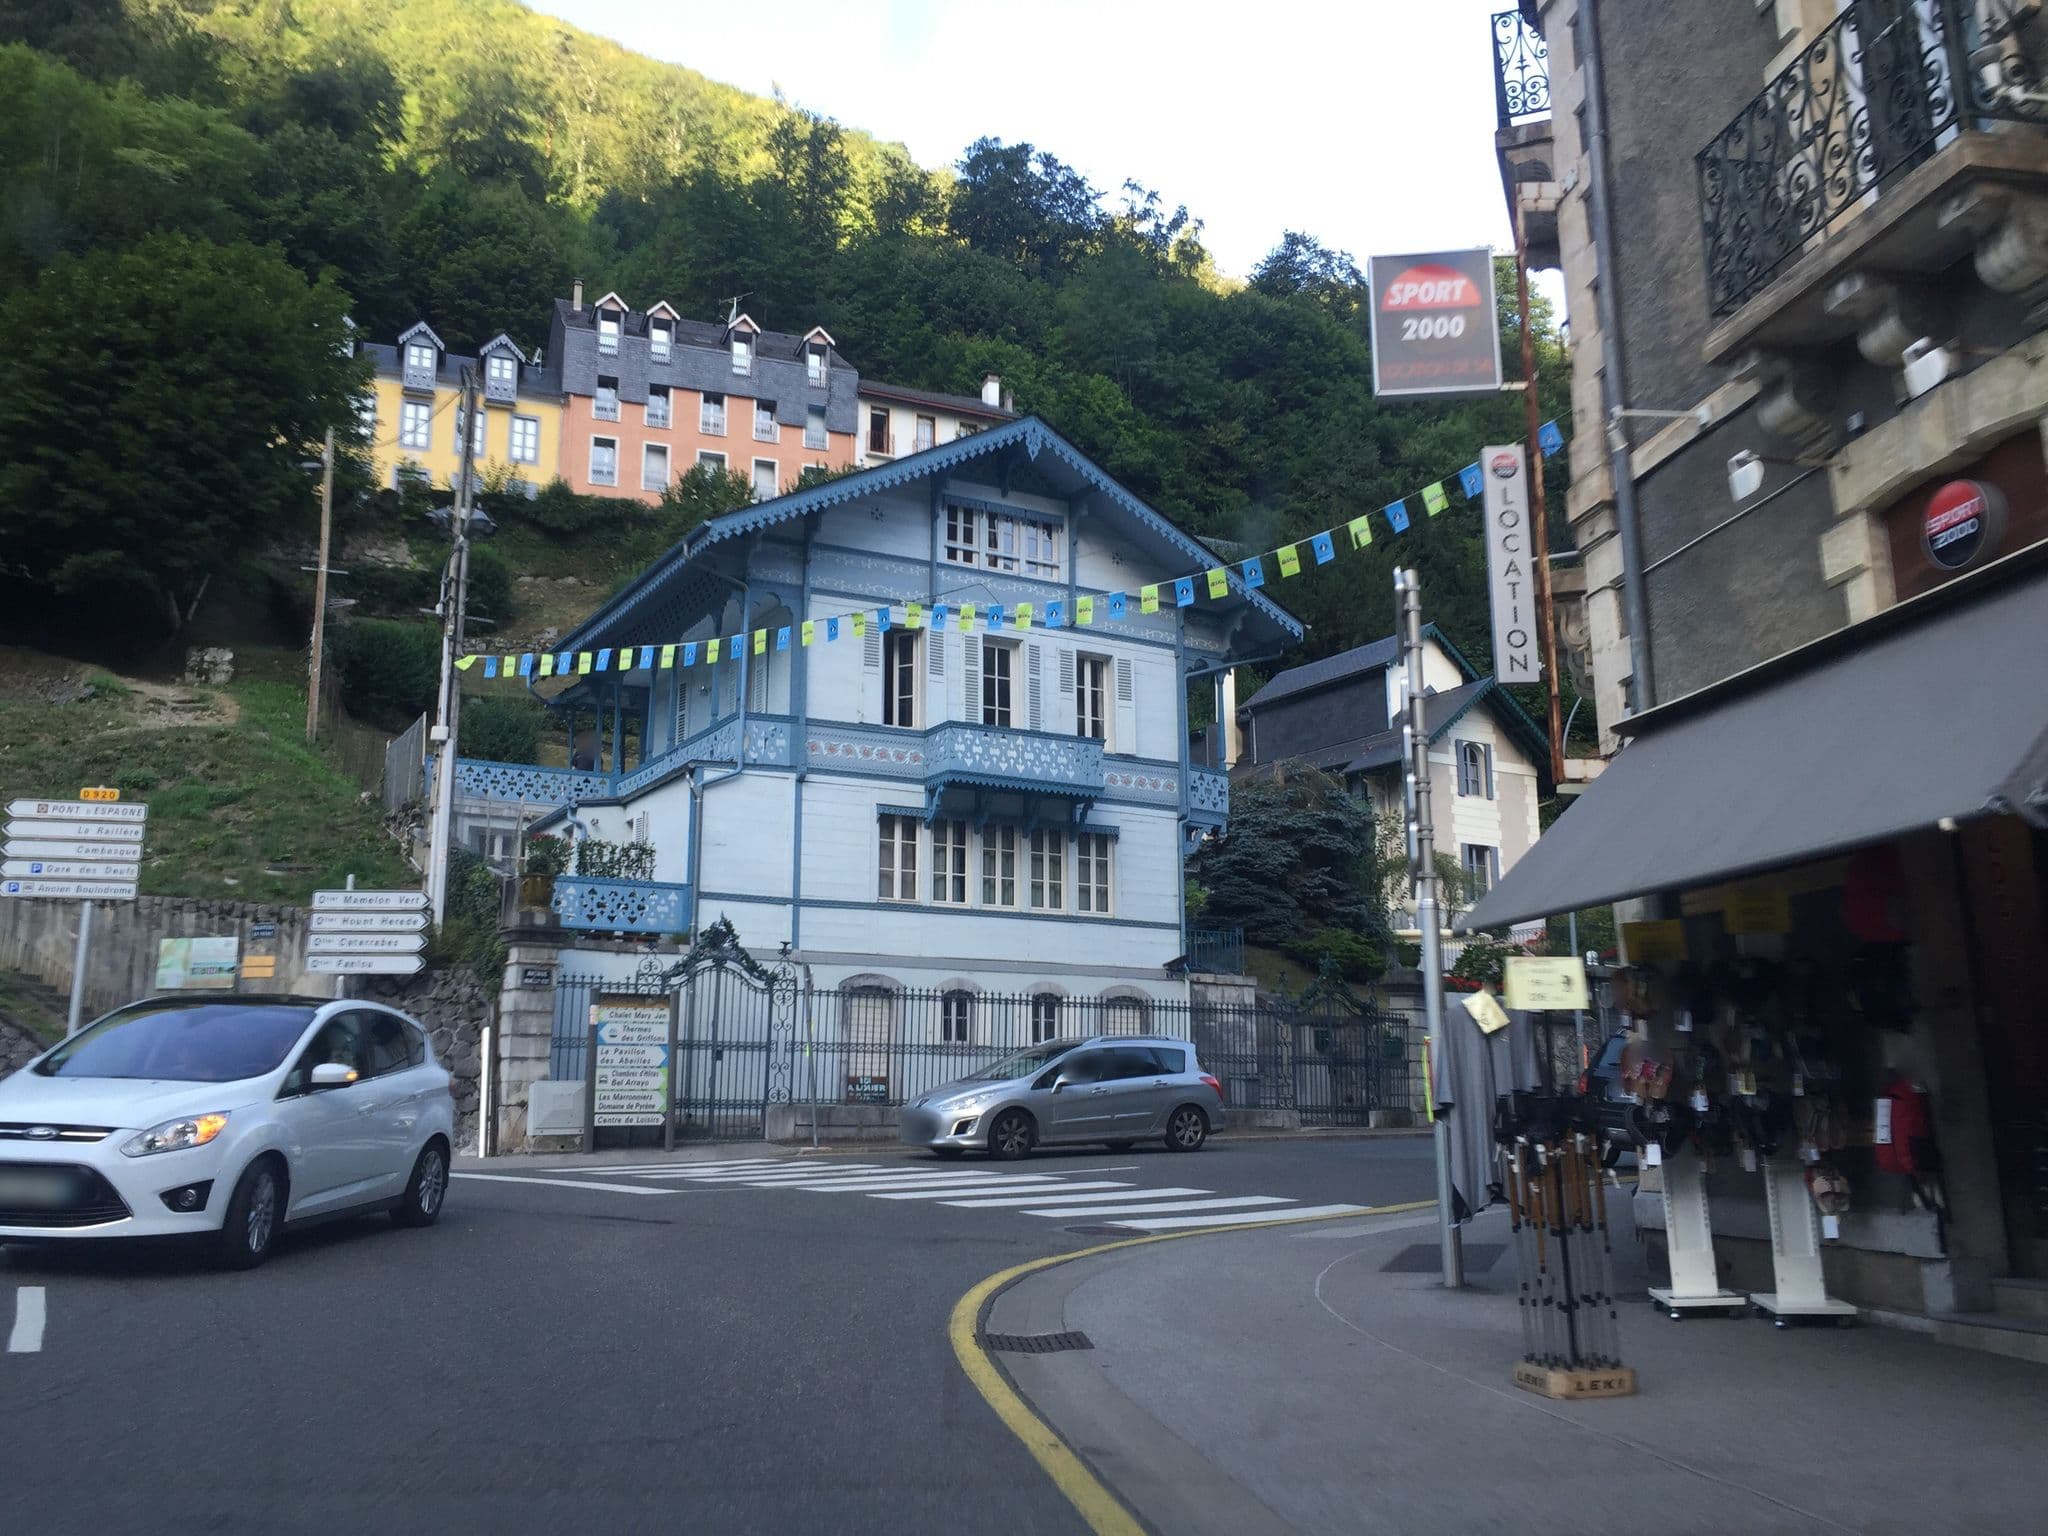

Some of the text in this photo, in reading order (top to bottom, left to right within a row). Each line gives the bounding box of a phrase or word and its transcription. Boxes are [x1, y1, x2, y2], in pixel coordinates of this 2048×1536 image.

[1388, 279, 1468, 306] SPORT
[1400, 314, 1466, 341] 2000
[1926, 496, 1981, 535] SPORT
[1930, 517, 1979, 549] 2000
[1498, 487, 1529, 673] LOCATION
[83, 790, 116, 799] D 920
[52, 803, 80, 814] PONT
[46, 864, 72, 874] Gare
[79, 864, 97, 874] des
[38, 885, 71, 893] Ancien
[76, 885, 134, 895] Boulodrome
[343, 896, 392, 904] Mamelon
[399, 896, 420, 904] Vert
[342, 916, 374, 925] Hount
[609, 1010, 632, 1018] Chalet
[634, 1010, 652, 1020] Mary
[622, 1024, 651, 1032] Thermes
[636, 1034, 665, 1042] Griffons
[613, 1047, 646, 1055] Pavillon
[624, 1078, 649, 1087] Arrayo
[612, 1093, 653, 1101] Marronniers
[598, 1102, 625, 1110] Domaine
[626, 1102, 634, 1110] de
[597, 1116, 659, 1124] Centre de Loisirs
[1574, 1378, 1624, 1392] LEKI
